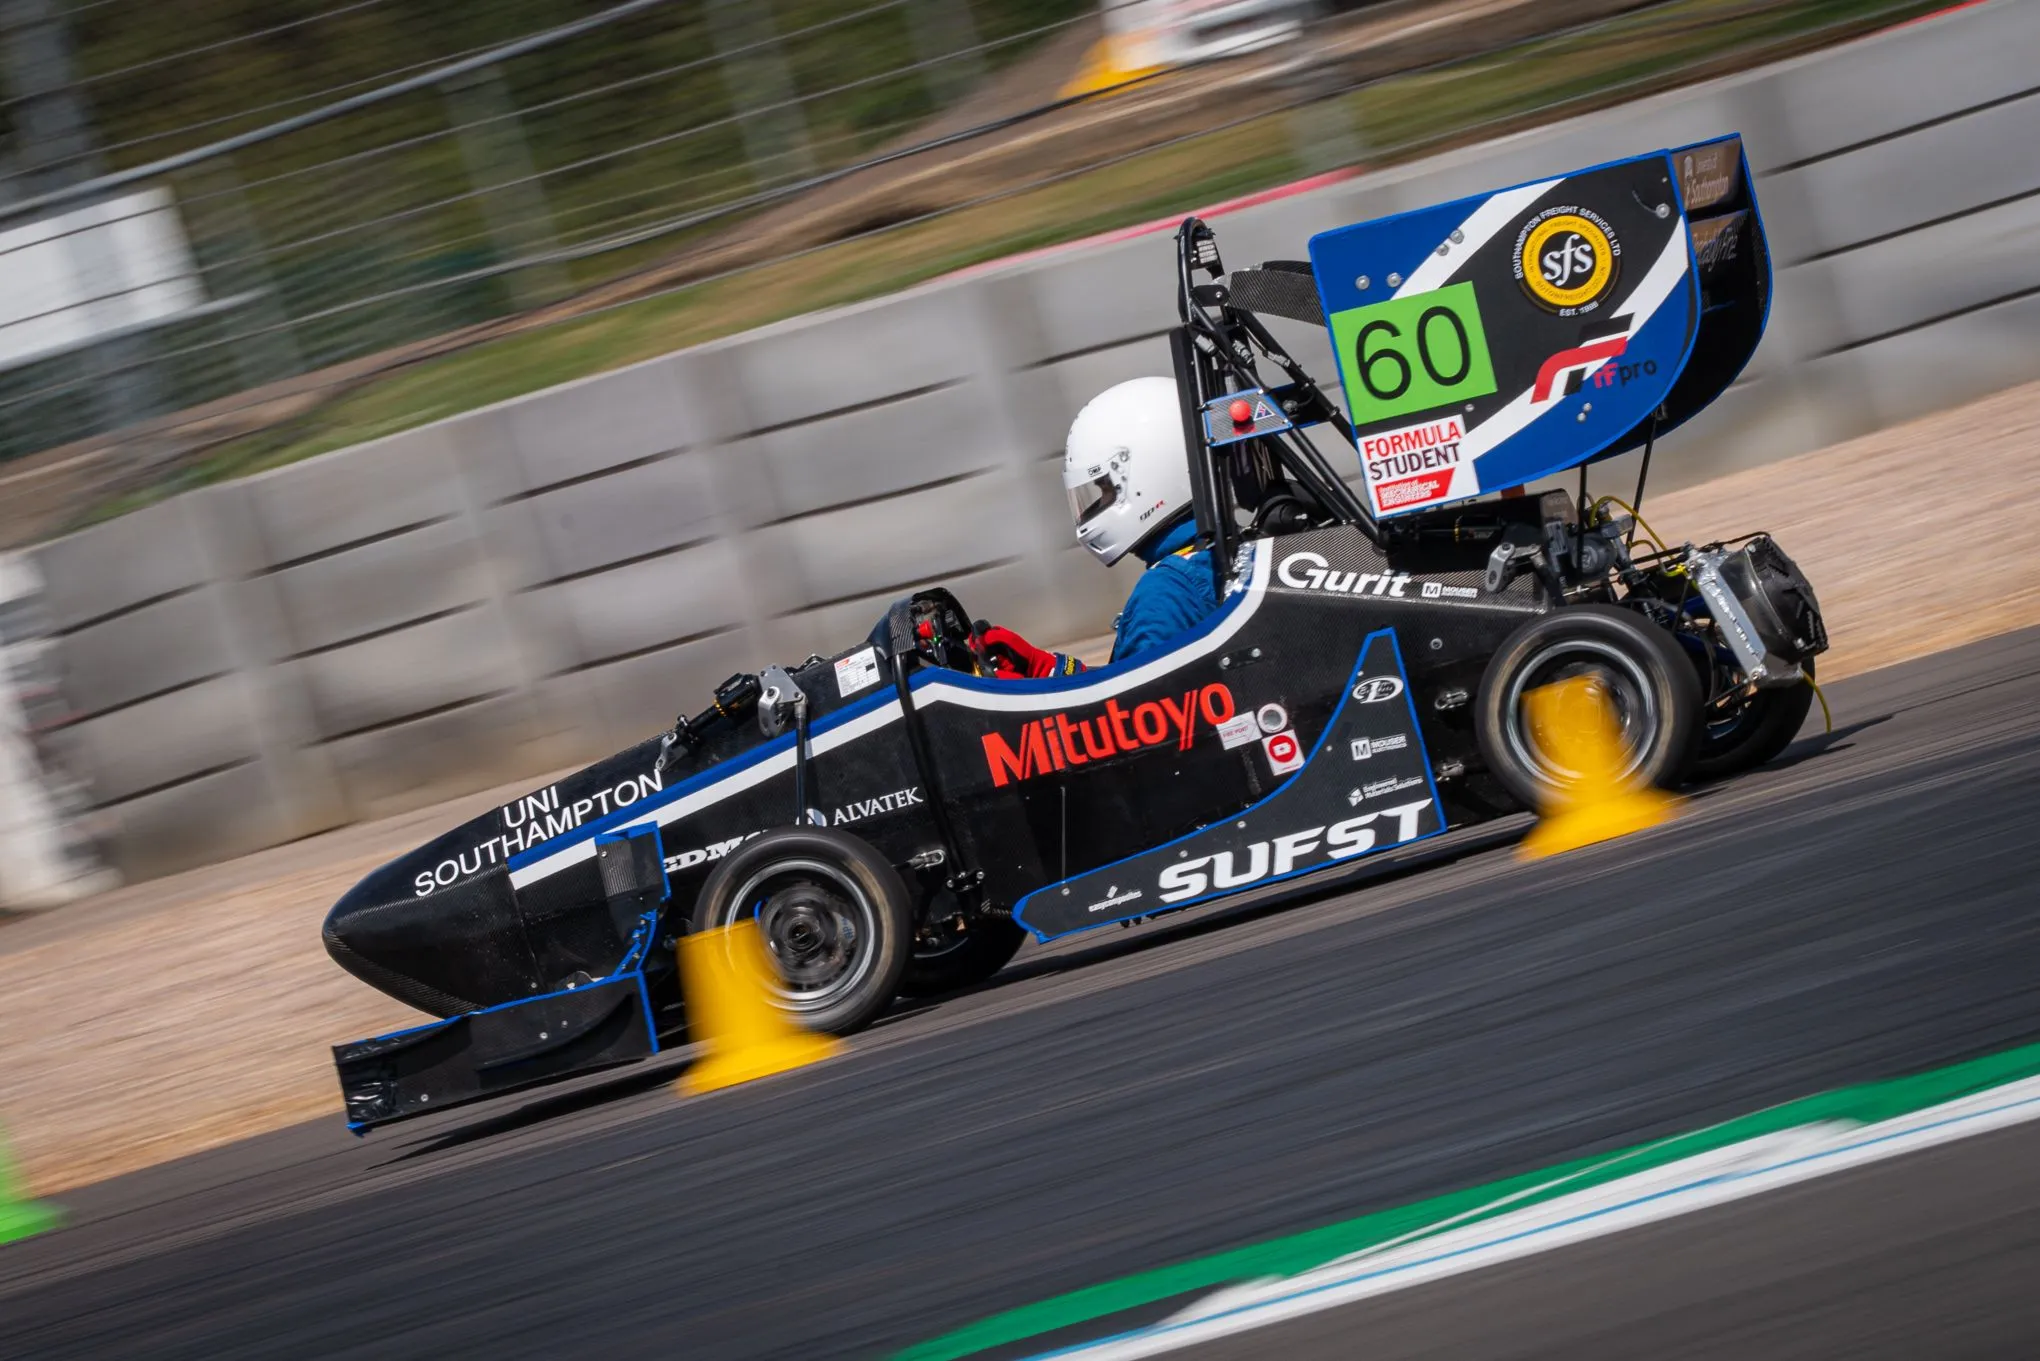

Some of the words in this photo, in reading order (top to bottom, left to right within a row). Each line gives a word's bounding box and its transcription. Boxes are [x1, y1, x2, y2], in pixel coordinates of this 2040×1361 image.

[1512, 215, 1542, 280] SOUTHAMPTON
[1540, 205, 1579, 220] FREIGHT
[1579, 207, 1616, 240] SERVICES
[1609, 239, 1621, 257] LTD
[1542, 233, 1594, 287] sfs
[1356, 305, 1471, 400] 60
[1363, 421, 1462, 460] FORMULA
[1369, 442, 1460, 480] STUDENT
[1278, 551, 1412, 597] Gurit
[981, 682, 1235, 788] Mitutoyo
[415, 769, 663, 897] SOUTHAMPTON
[503, 785, 559, 828] UNI
[833, 786, 924, 826] ALVATEK
[1158, 797, 1434, 904] SUFST
